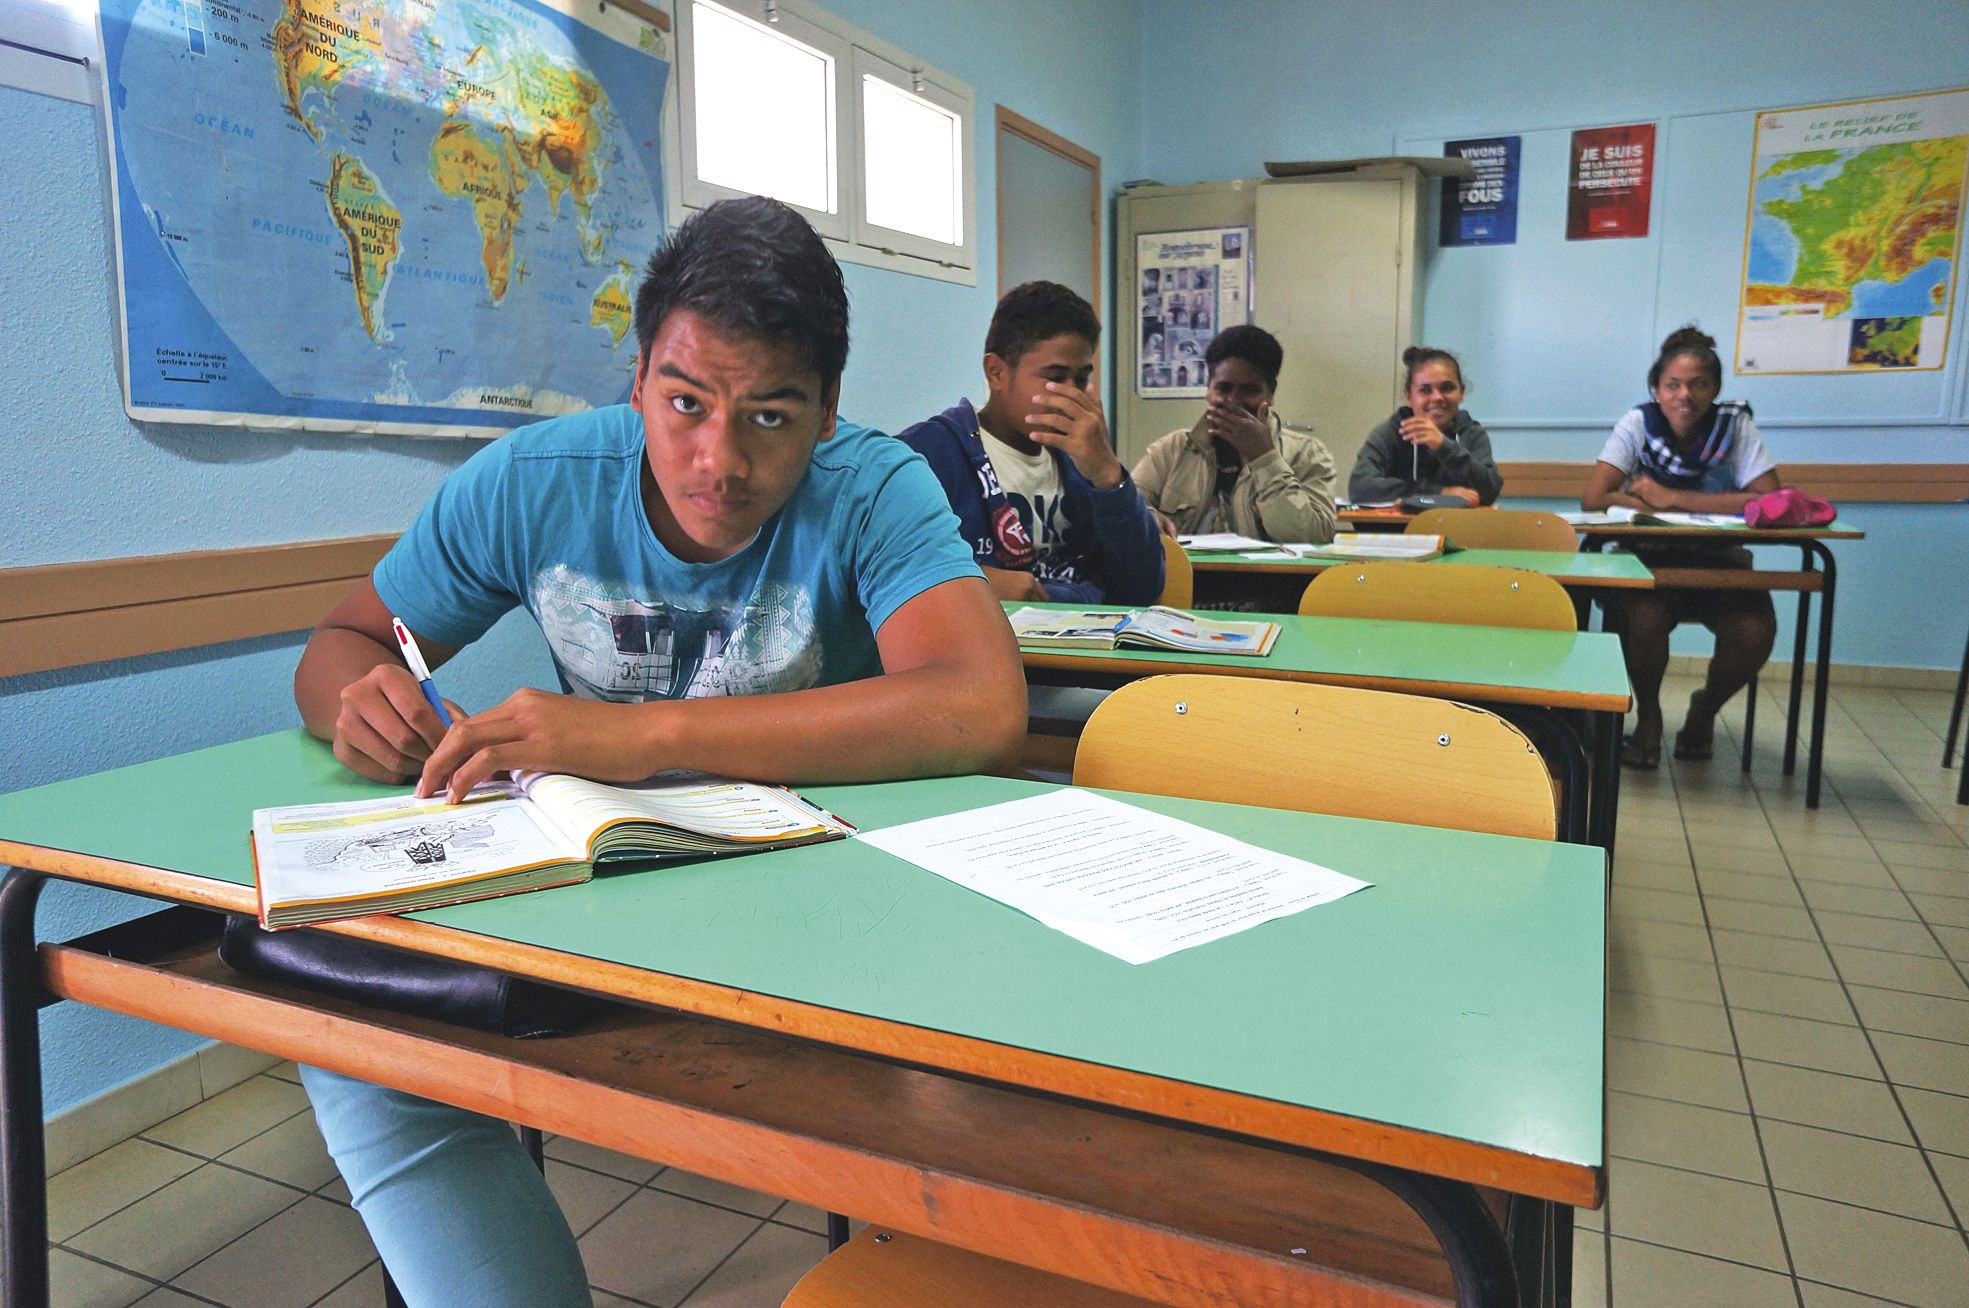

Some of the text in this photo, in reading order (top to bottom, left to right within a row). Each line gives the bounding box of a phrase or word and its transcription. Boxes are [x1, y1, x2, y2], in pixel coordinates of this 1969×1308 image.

[211, 6, 228, 19] 200
[230, 14, 240, 23] m
[301, 8, 360, 42] AMÉRIQUE
[240, 42, 249, 51] m
[319, 31, 337, 48] DU
[305, 41, 338, 63] NORD
[457, 80, 497, 99] EUROPE
[1808, 111, 1918, 130] LE RELIEF DE
[1803, 120, 1923, 142] LA FRANCE
[1460, 145, 1506, 159] VIVONS
[1580, 144, 1643, 161] JE SUIS
[1459, 188, 1504, 204] FOUS
[343, 207, 401, 229] AMÉRIQUE
[252, 218, 333, 246] PACIFIQUE
[361, 227, 377, 239] DU
[361, 242, 385, 256] SUD
[397, 263, 486, 287] ATLANTIQUE
[480, 394, 533, 409] ANTARCTIQUE
